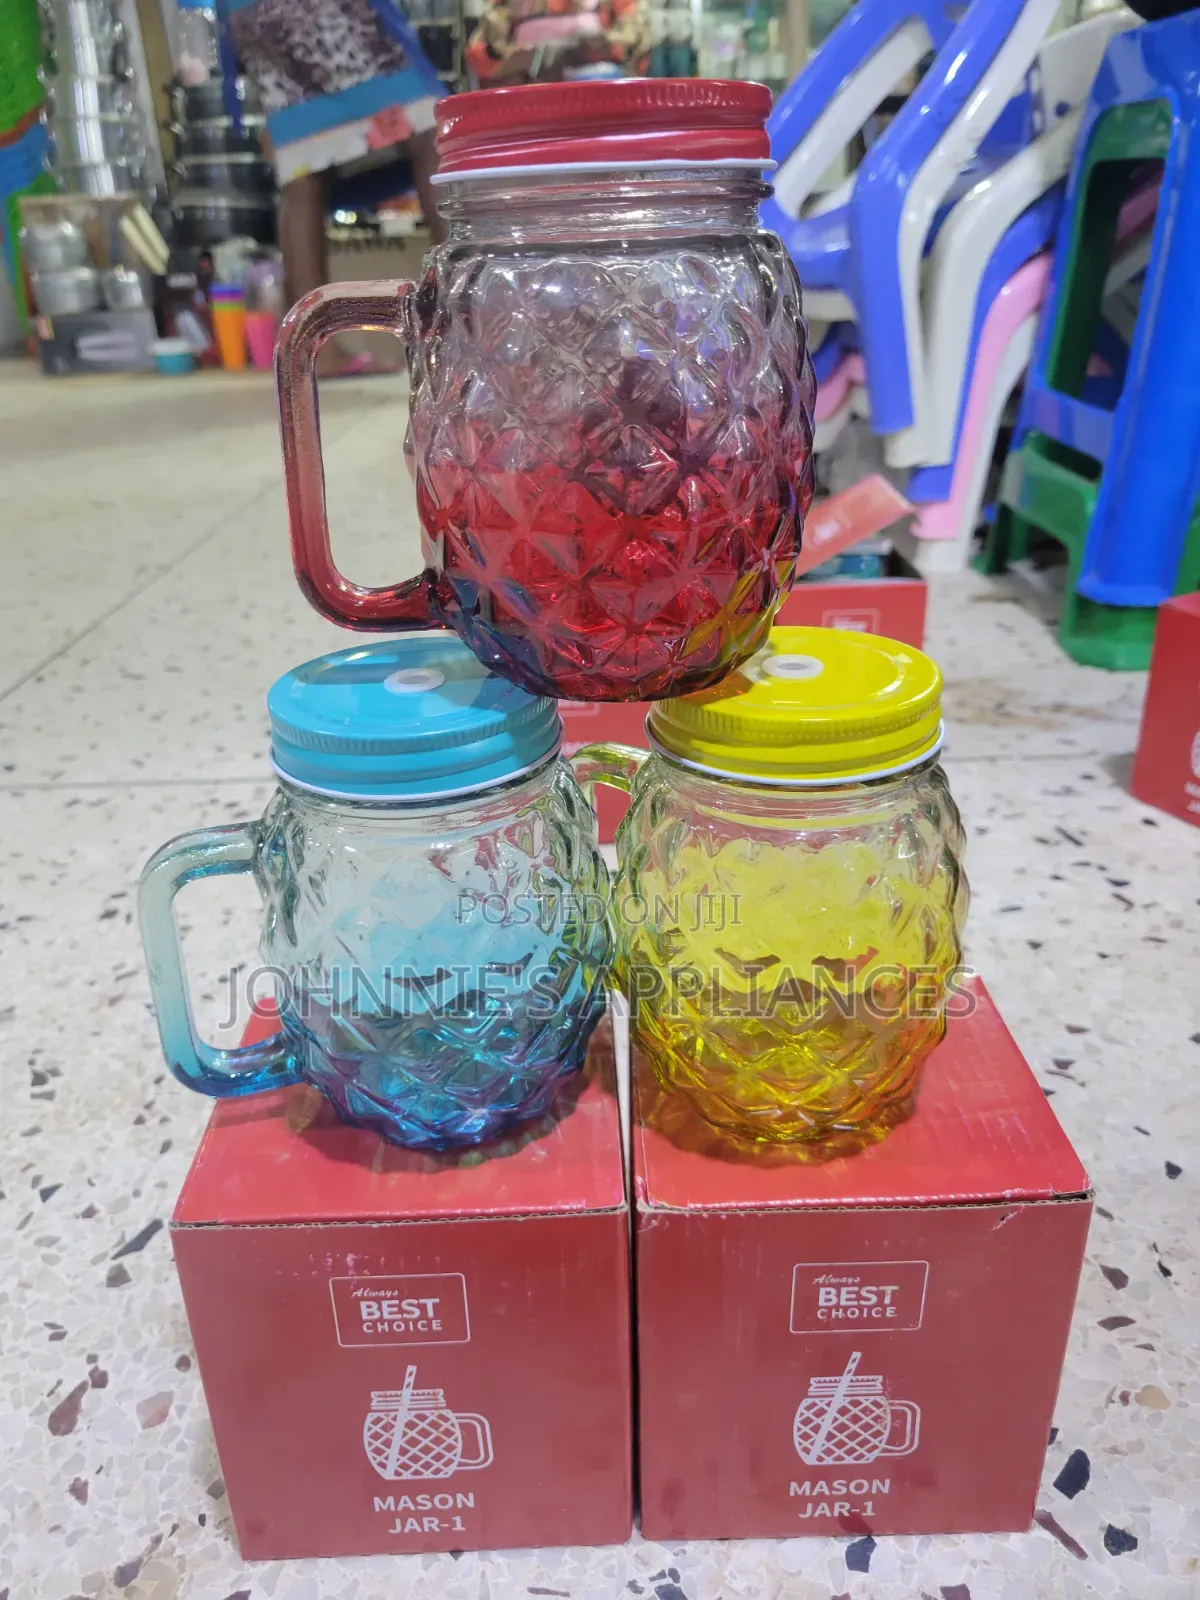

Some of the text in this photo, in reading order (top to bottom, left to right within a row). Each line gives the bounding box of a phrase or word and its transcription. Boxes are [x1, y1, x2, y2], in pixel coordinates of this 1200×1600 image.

[812, 1274, 860, 1284] Always
[351, 1287, 398, 1297] Always
[818, 1285, 899, 1306] BEST
[360, 1298, 440, 1320] BEST
[817, 1306, 897, 1319] CHOICE
[363, 1319, 442, 1333] CHOICE
[789, 1479, 890, 1497] MASON
[373, 1493, 475, 1512] MASON
[799, 1501, 875, 1518] JAR-1
[388, 1516, 466, 1534] JAR-1
